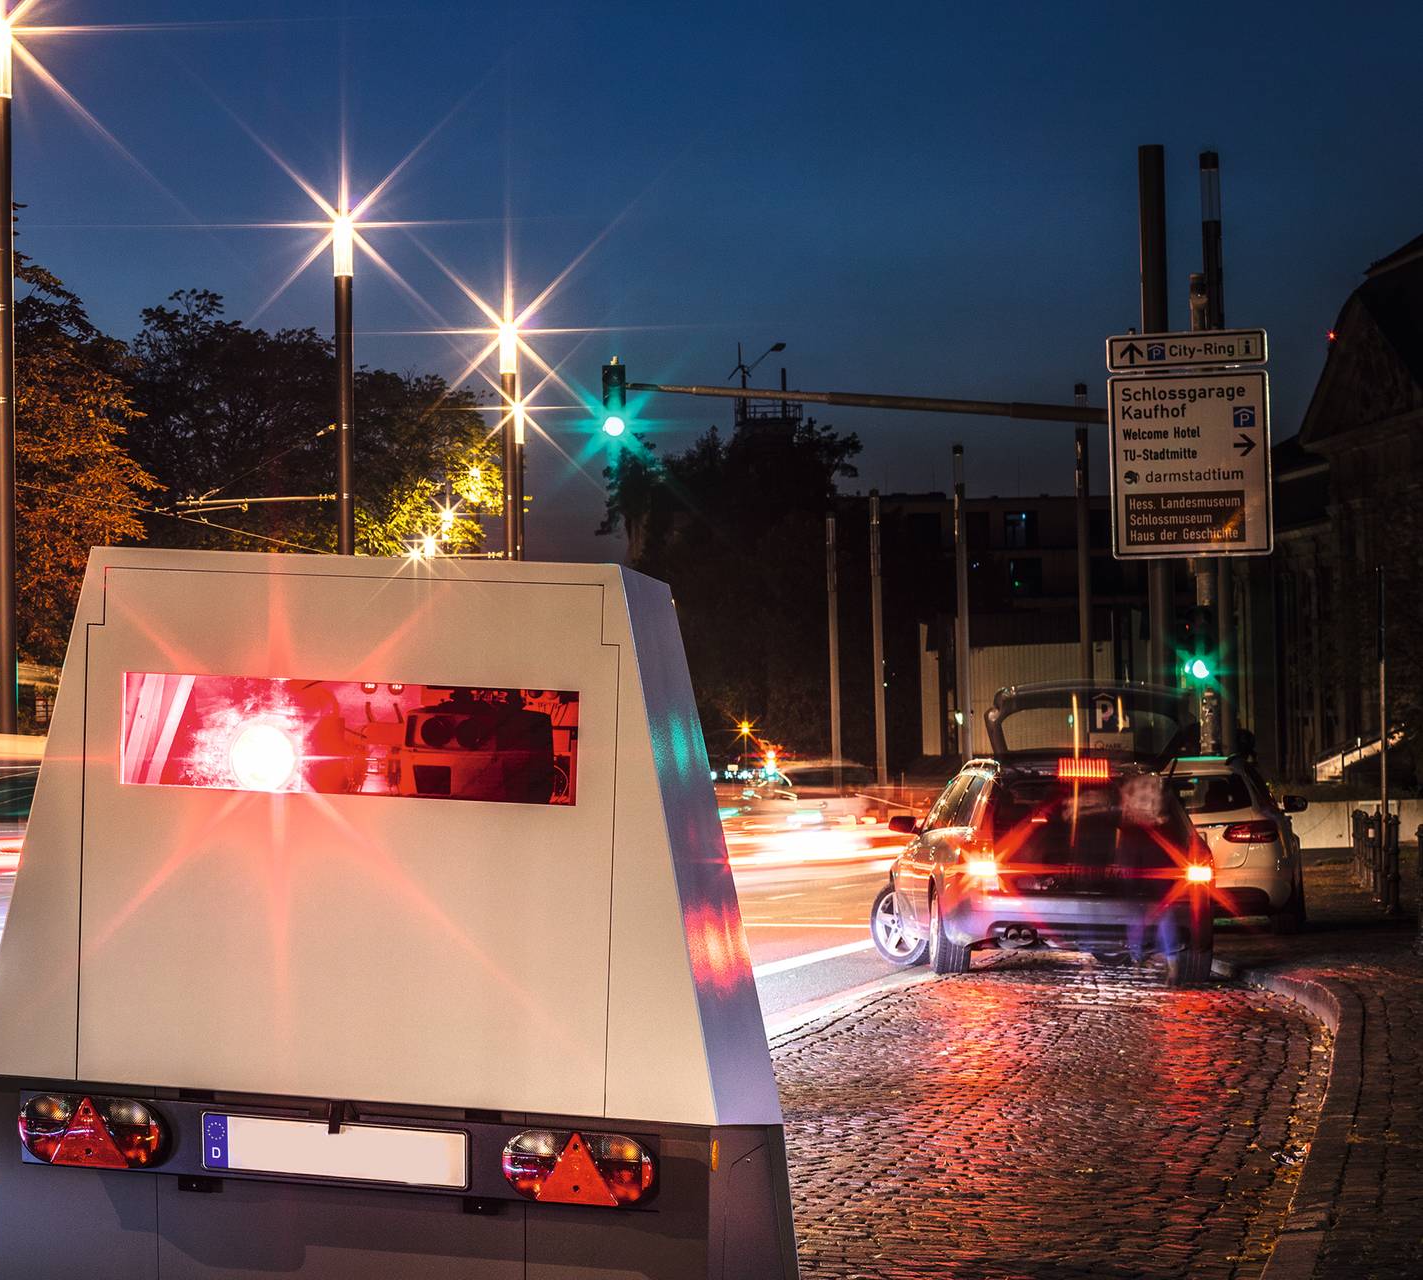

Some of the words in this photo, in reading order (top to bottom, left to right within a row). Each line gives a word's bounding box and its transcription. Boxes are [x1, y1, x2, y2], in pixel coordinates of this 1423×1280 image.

[1169, 342, 1235, 358] City-Ring
[1121, 386, 1246, 403] Schlossgarage
[1121, 403, 1186, 420] Kaufhof
[1239, 413, 1250, 426] P
[1123, 428, 1169, 441] Welcome
[1173, 426, 1201, 439] Hotel
[1123, 448, 1198, 461] TU-Stadtmitte
[1145, 468, 1244, 483] darmstadtium
[1129, 498, 1156, 510] Hess.
[1161, 496, 1241, 509] Landesmuseum
[1129, 513, 1213, 526] Schlossmuseum
[1130, 530, 1155, 542] Haus
[1160, 529, 1177, 540] der
[1182, 527, 1238, 540] Geschichte
[211, 1146, 221, 1158] D
